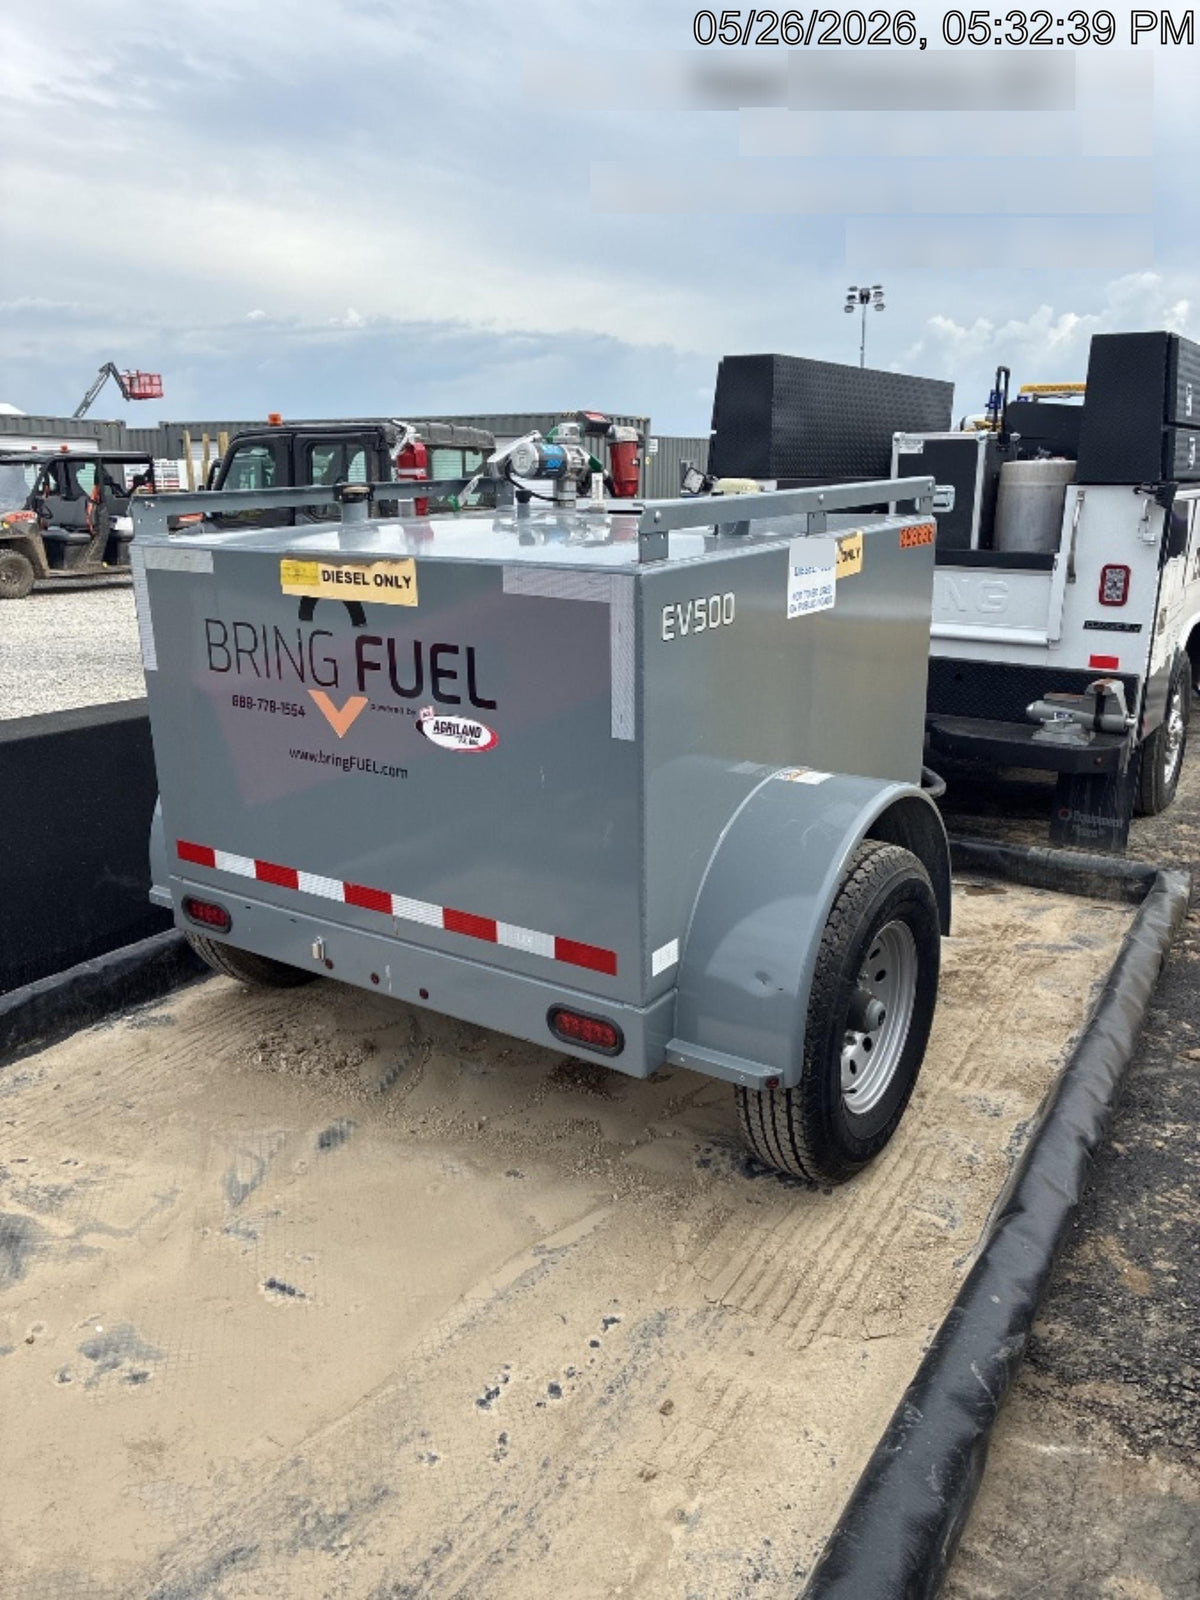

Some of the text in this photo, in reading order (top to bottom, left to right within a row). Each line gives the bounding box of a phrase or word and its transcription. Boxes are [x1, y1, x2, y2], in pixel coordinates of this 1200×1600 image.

[322, 570, 370, 586] DIESEL
[374, 574, 412, 589] ONLY
[662, 592, 735, 641] EV500
[204, 618, 498, 710] BRING FUEL
[433, 720, 483, 739] AGRILAND
[289, 747, 408, 780] www.bringFUEL.com
